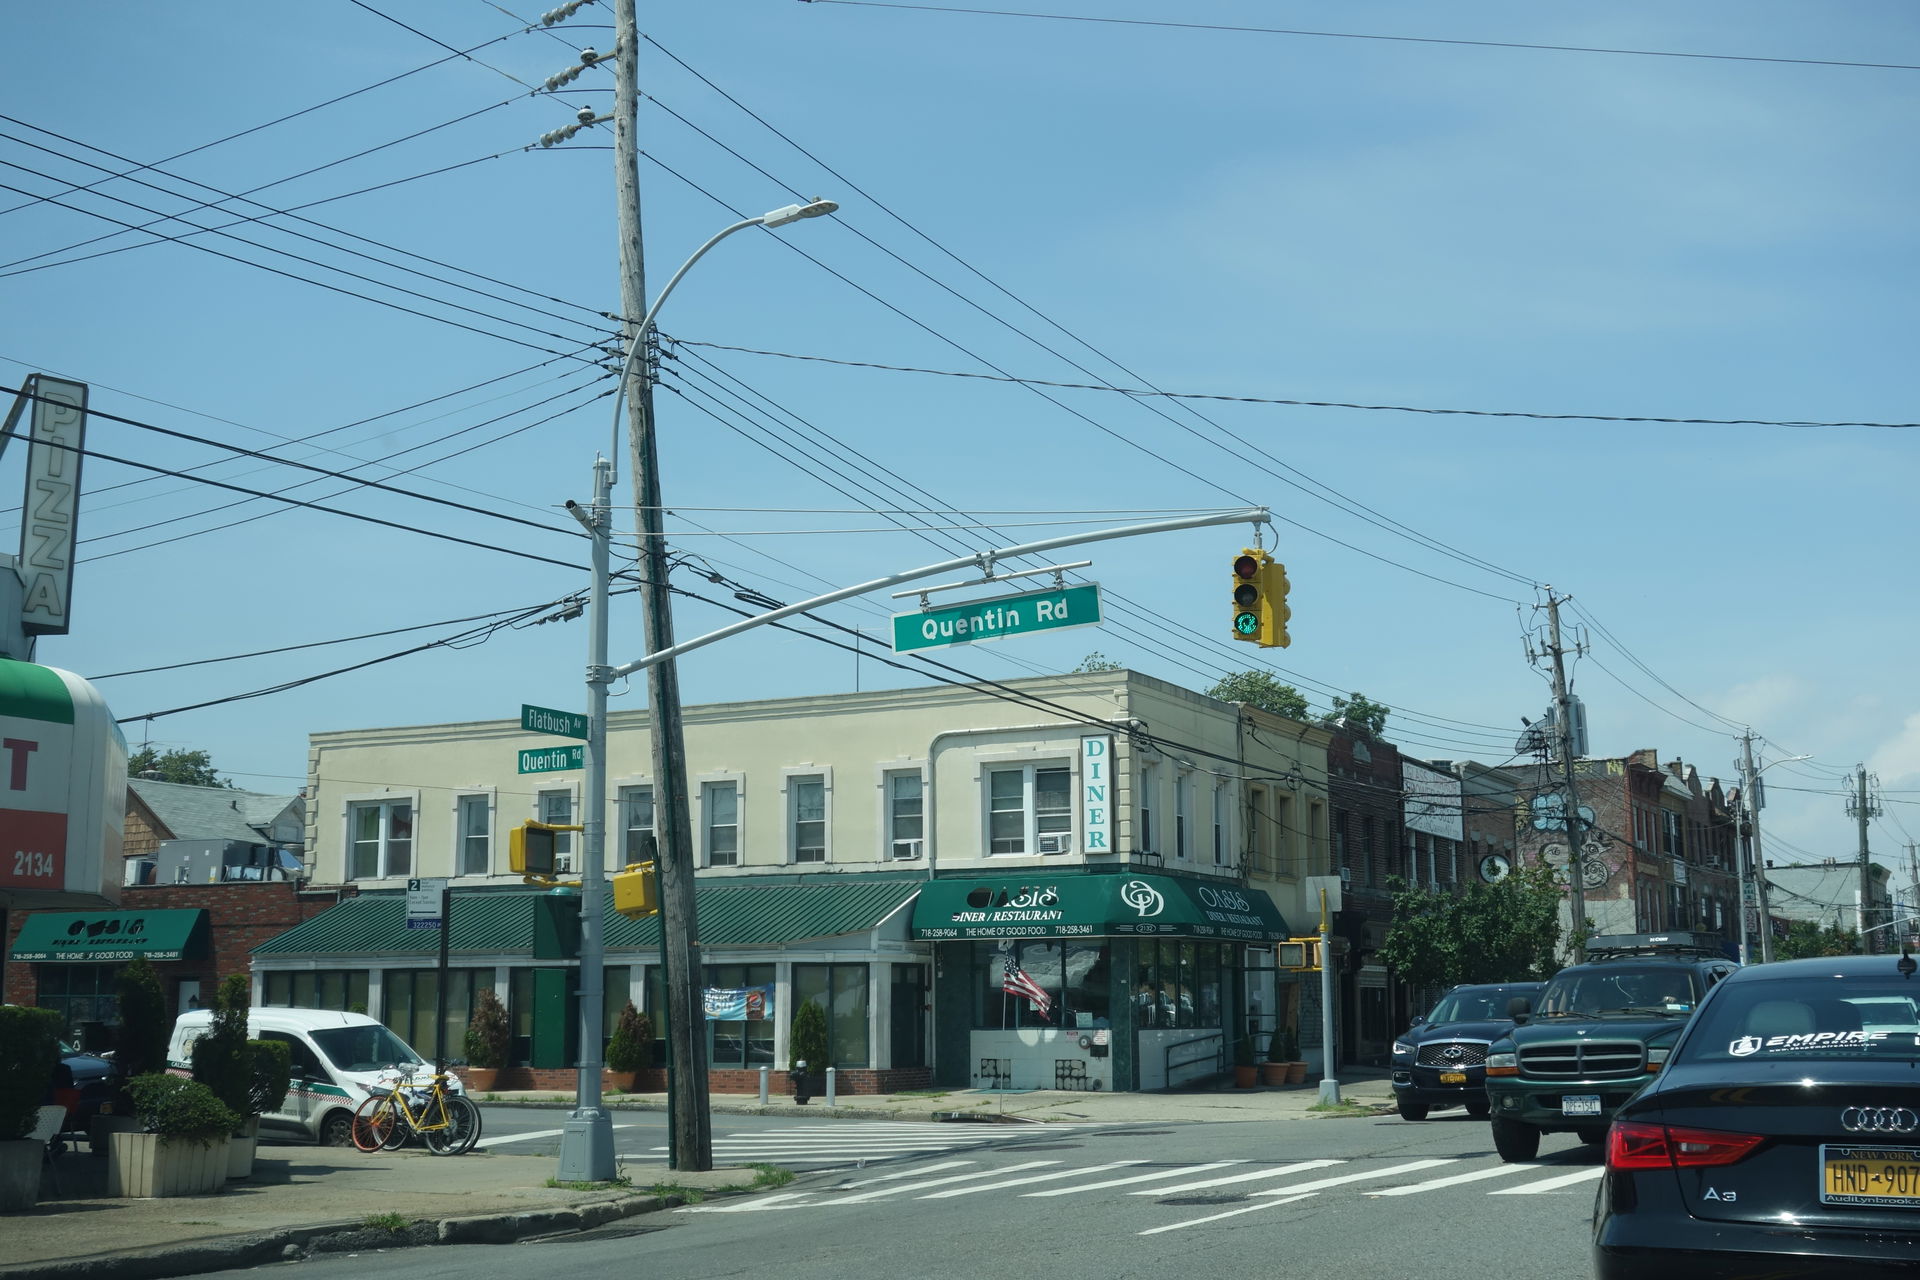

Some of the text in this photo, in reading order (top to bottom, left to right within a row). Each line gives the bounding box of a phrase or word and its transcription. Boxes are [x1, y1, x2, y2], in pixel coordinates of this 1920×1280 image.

[22, 391, 78, 616] PIZZA
[921, 597, 1068, 640] Quentin Rd
[529, 709, 582, 733] Flatbush Av
[522, 749, 582, 771] Quentin Rd
[1086, 740, 1107, 848] DINER
[13, 850, 54, 878] 2134
[411, 880, 418, 890] 2
[1198, 886, 1250, 912] OASIS
[993, 910, 1064, 922] RESTAURANT
[921, 925, 1093, 937] 718-258-9064 THE HOME OF GOOD FOOD 718-258-3461
[66, 952, 84, 960] HOME
[115, 951, 134, 959] FOOD
[1766, 1031, 1892, 1046] EMPIRE
[1850, 1150, 1914, 1161] NEW YORK
[1703, 1187, 1737, 1202] A3
